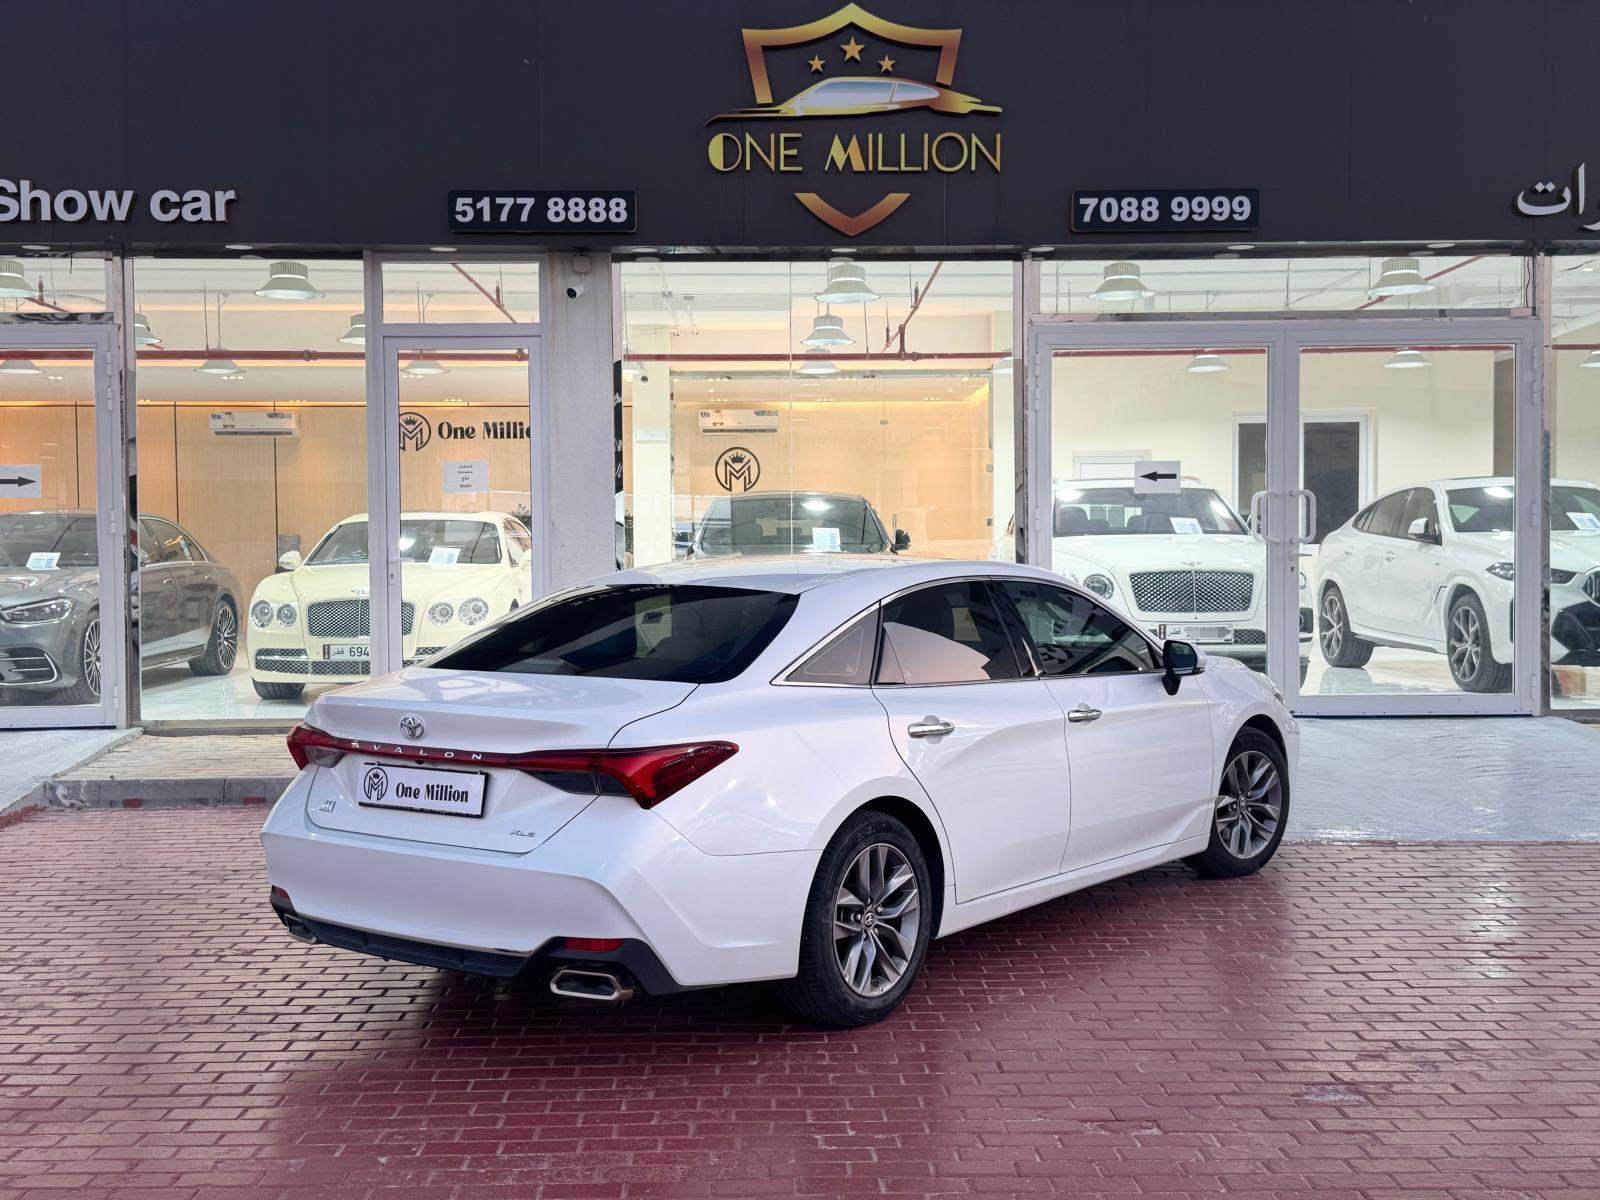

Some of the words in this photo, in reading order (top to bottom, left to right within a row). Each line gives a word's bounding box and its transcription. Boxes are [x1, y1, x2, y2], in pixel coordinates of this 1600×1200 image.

[707, 132, 803, 172] ONE
[824, 131, 1001, 172] MILLION
[149, 188, 236, 223] car
[454, 196, 535, 223] 5177
[546, 197, 628, 223] 8888
[1079, 196, 1160, 223] 7088
[1170, 195, 1251, 222] 9999
[437, 421, 477, 440] One
[395, 782, 421, 800] One
[424, 783, 469, 803] Million
